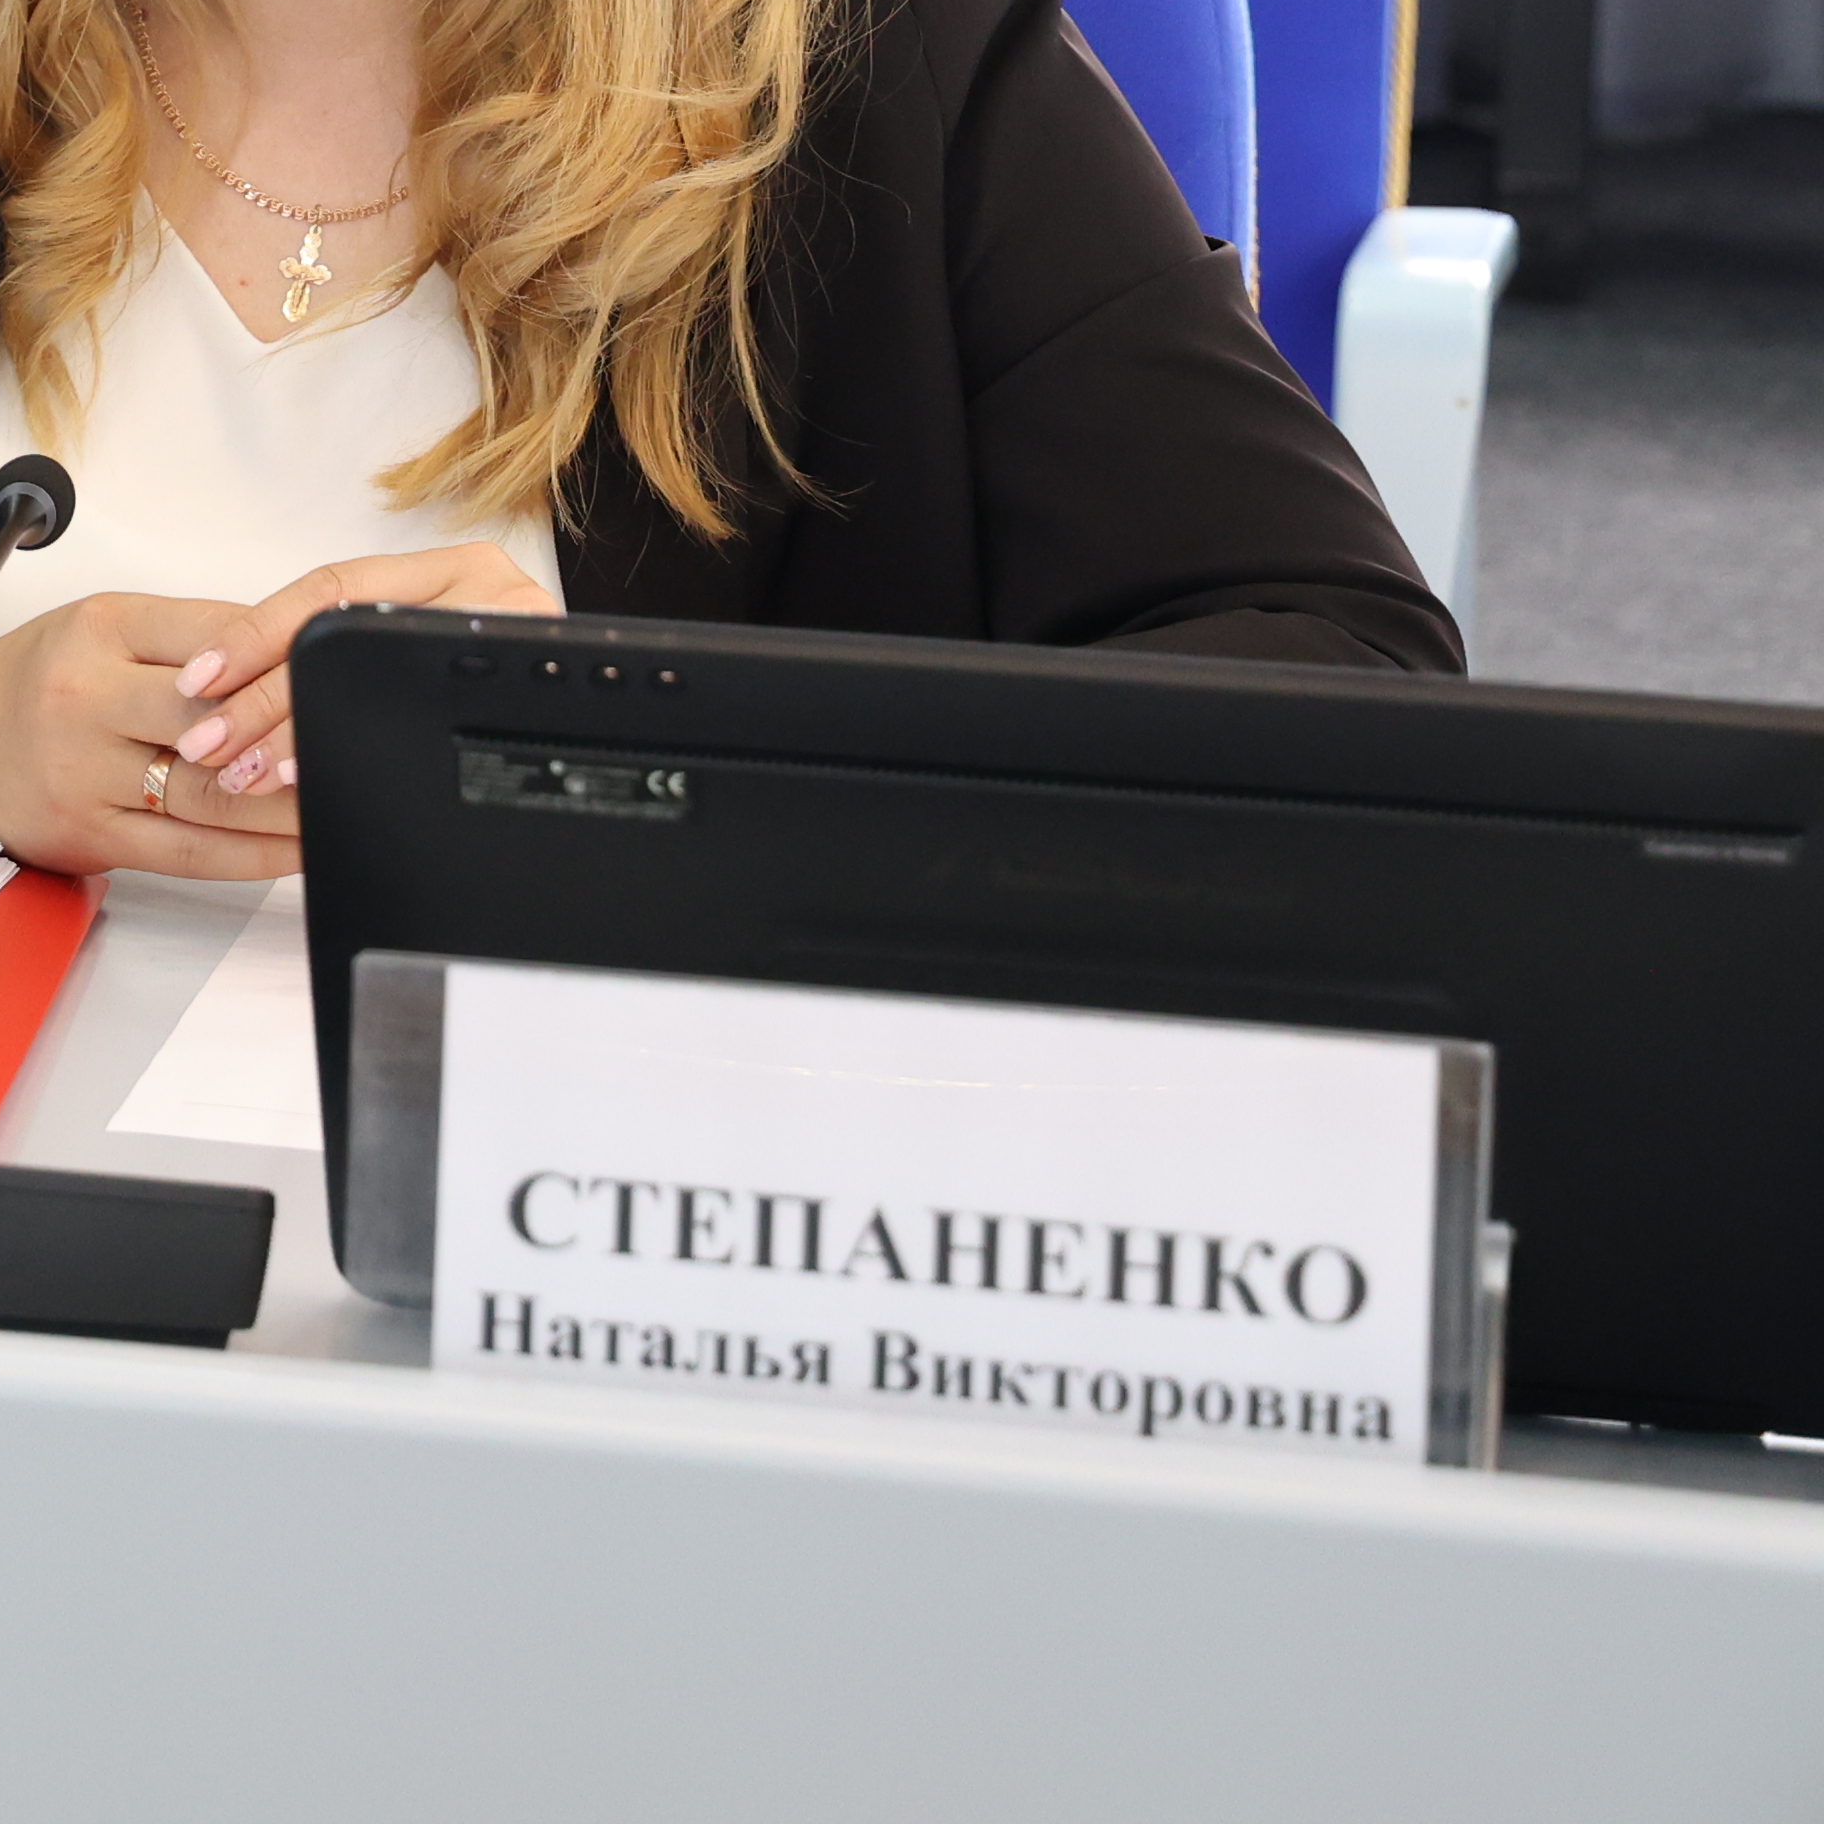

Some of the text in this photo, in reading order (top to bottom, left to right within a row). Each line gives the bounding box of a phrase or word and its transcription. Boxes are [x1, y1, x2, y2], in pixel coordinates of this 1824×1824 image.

[504, 1167, 1372, 1327] СТЕПАНЕНКО
[476, 1289, 1396, 1444] Наталья Викторовна
